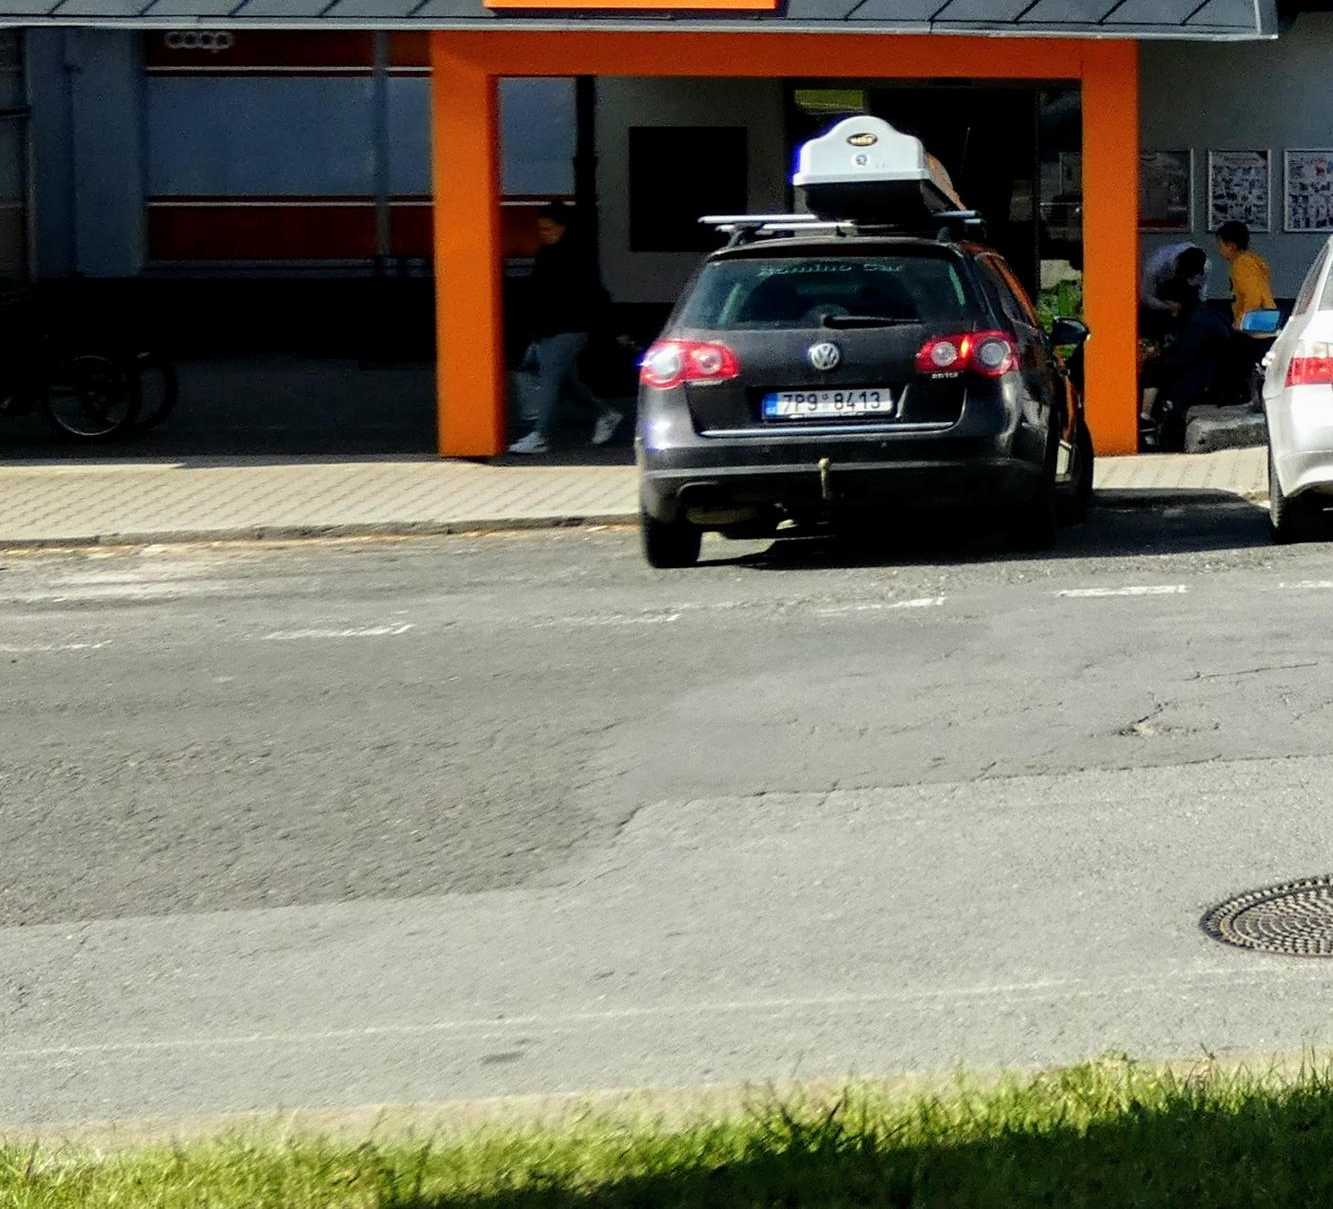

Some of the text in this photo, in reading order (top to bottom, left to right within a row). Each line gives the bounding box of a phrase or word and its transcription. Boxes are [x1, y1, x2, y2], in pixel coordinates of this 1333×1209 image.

[164, 31, 234, 53] coop
[783, 393, 818, 413] 7P9
[833, 391, 881, 410] 8413
